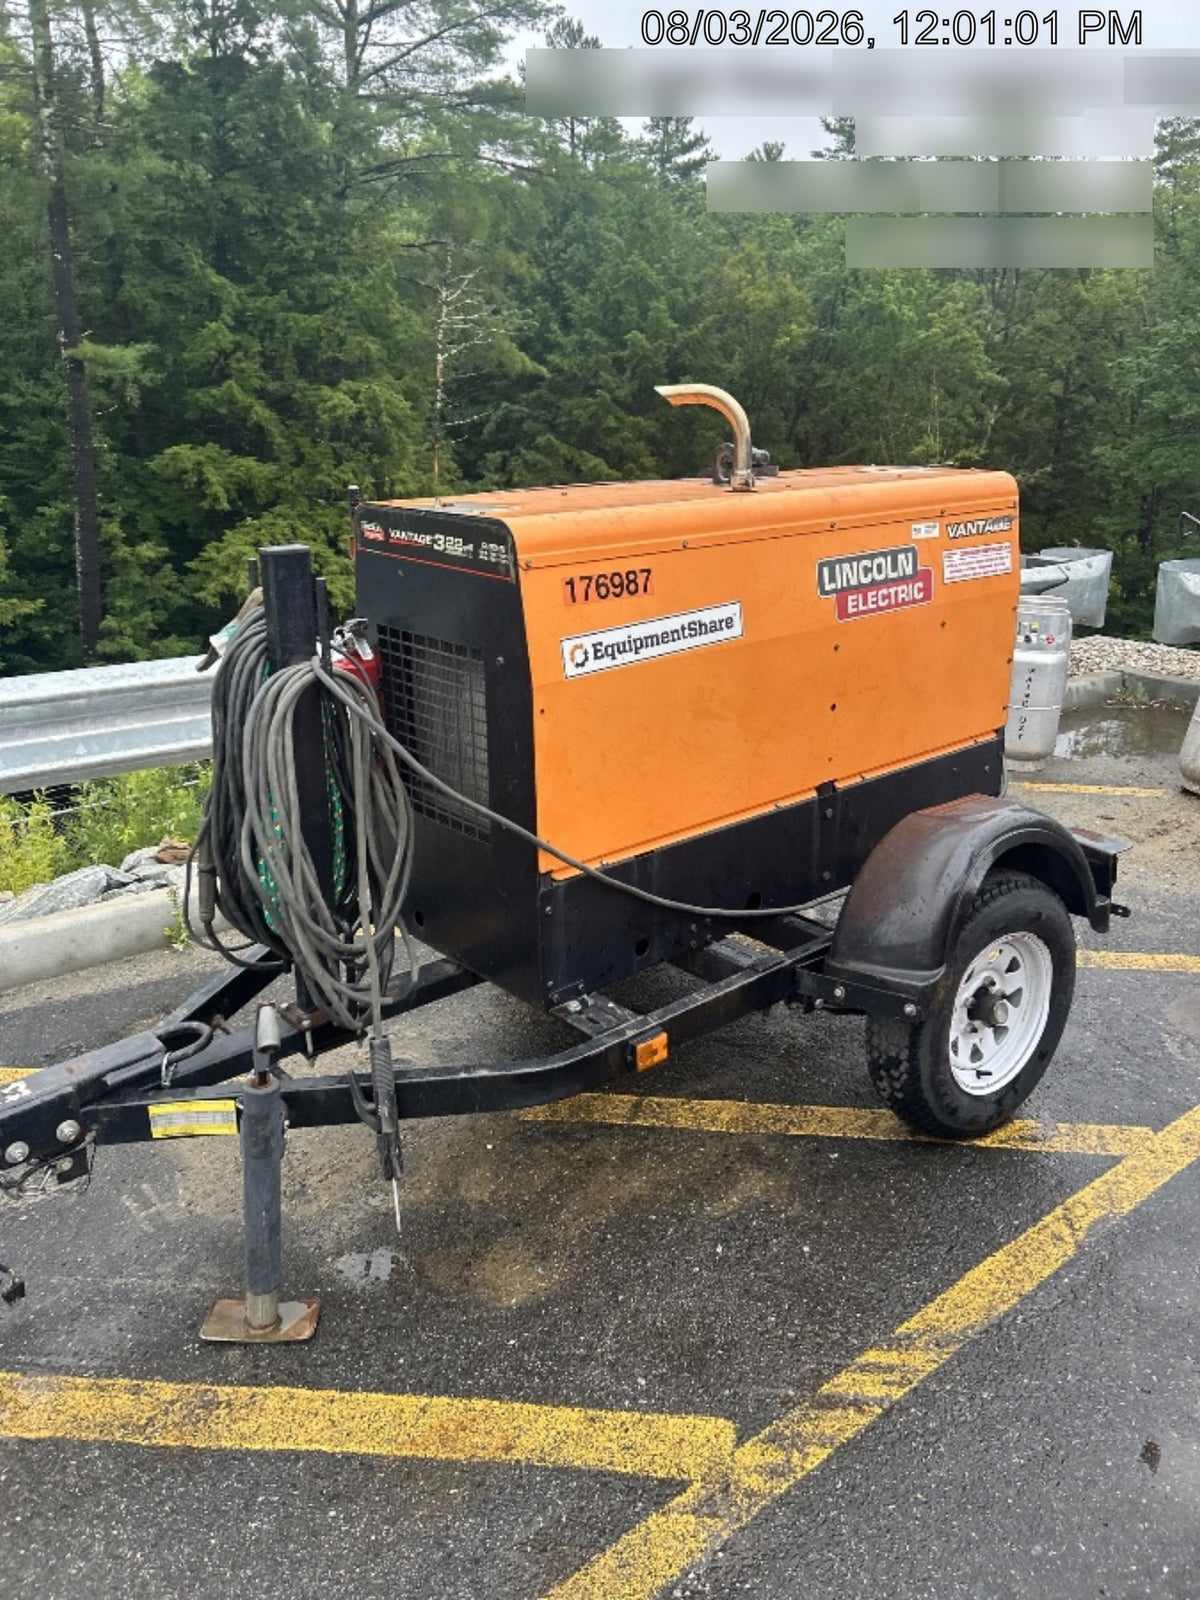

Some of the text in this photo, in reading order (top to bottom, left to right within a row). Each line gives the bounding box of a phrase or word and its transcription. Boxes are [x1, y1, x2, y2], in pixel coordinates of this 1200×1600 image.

[433, 533, 463, 552] 322
[564, 567, 653, 603] 176987
[822, 551, 914, 591] LINCOLN
[847, 581, 925, 614] ELECTRIC
[591, 613, 736, 661] EquipmentShare
